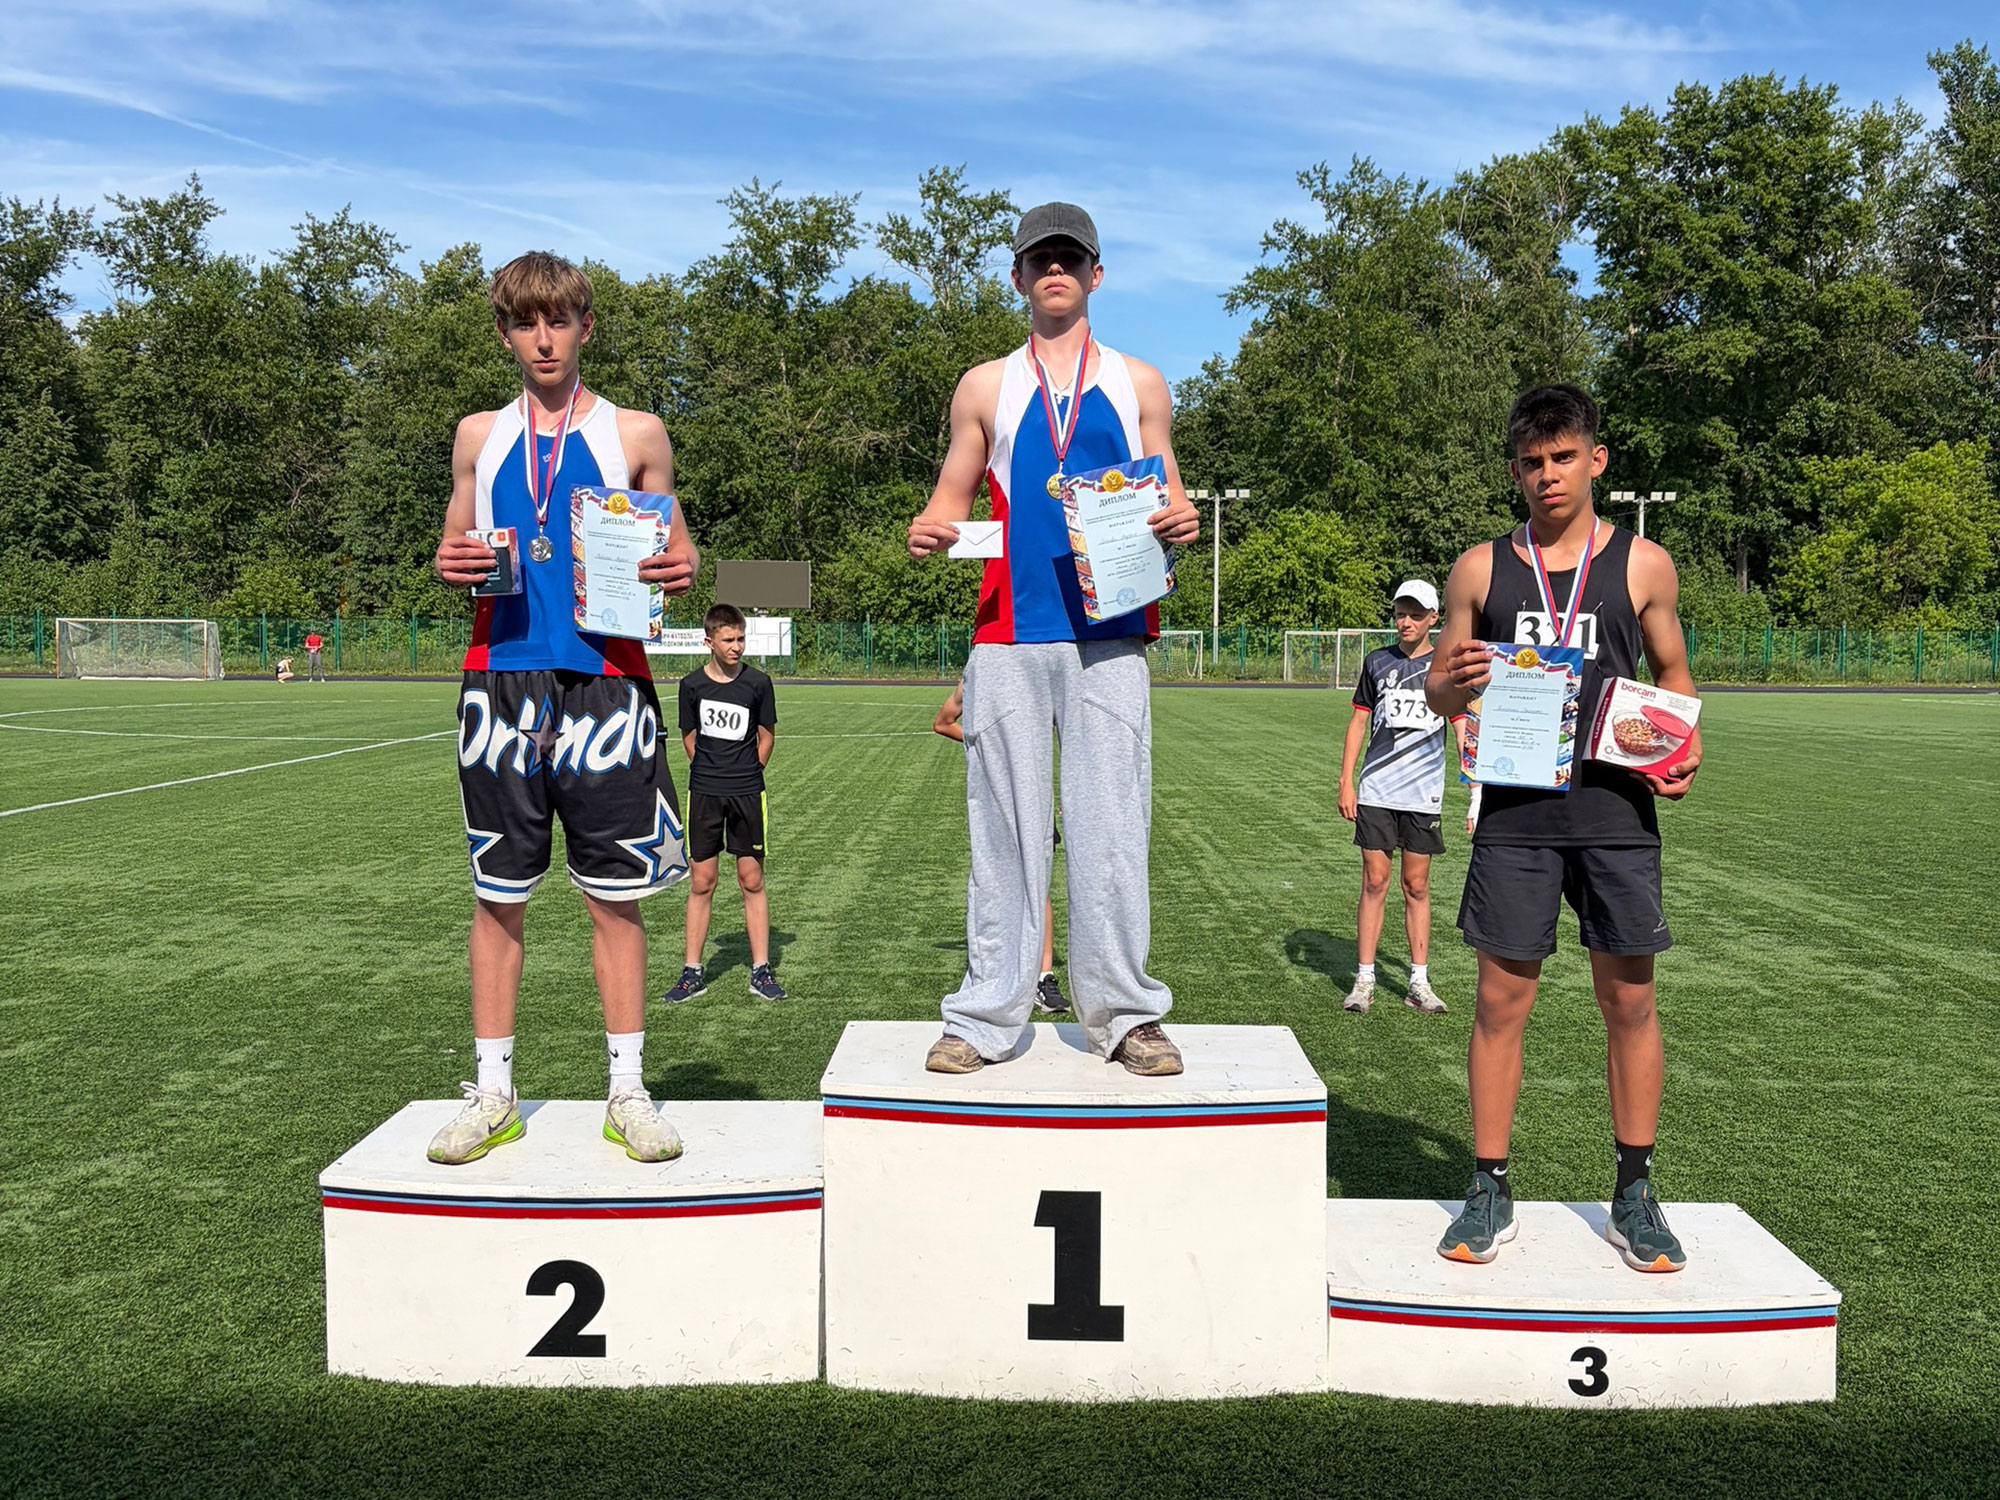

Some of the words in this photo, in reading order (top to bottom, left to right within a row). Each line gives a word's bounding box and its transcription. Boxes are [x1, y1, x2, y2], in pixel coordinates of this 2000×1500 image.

[1099, 493, 1137, 508] ДИПЛОМ
[600, 517, 636, 527] ДИПЛОМ
[1506, 671, 1545, 680] ДИПЛОМ
[1621, 682, 1657, 699] borcam
[1390, 699, 1428, 719] 373
[704, 708, 741, 731] 380
[1028, 1190, 1125, 1342] 1
[525, 1259, 606, 1357] 2
[1568, 1346, 1609, 1397] 3
